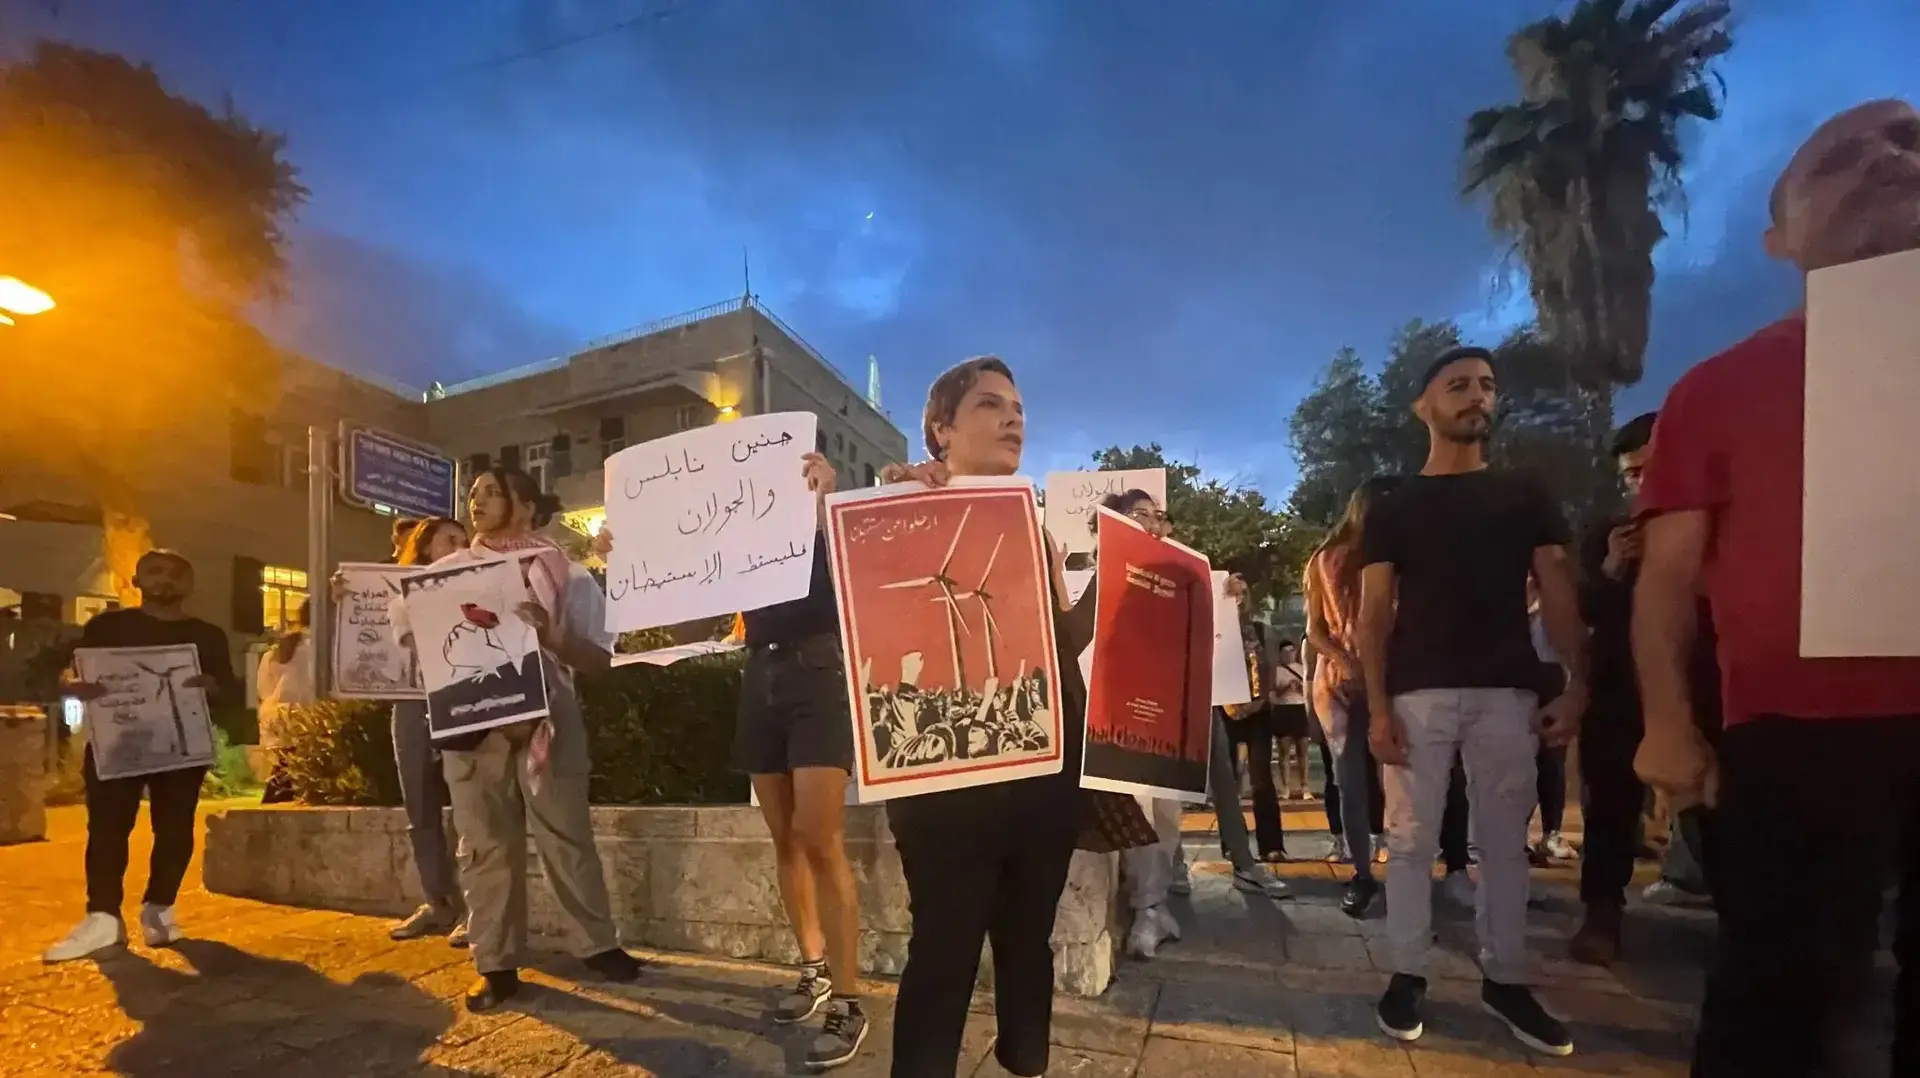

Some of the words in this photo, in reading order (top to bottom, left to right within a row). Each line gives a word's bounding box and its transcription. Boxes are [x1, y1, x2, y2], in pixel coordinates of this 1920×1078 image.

[732, 431, 793, 462] جنين
[624, 448, 705, 500] نابلس
[677, 477, 776, 535] والجولان
[738, 541, 808, 575] فليسقط
